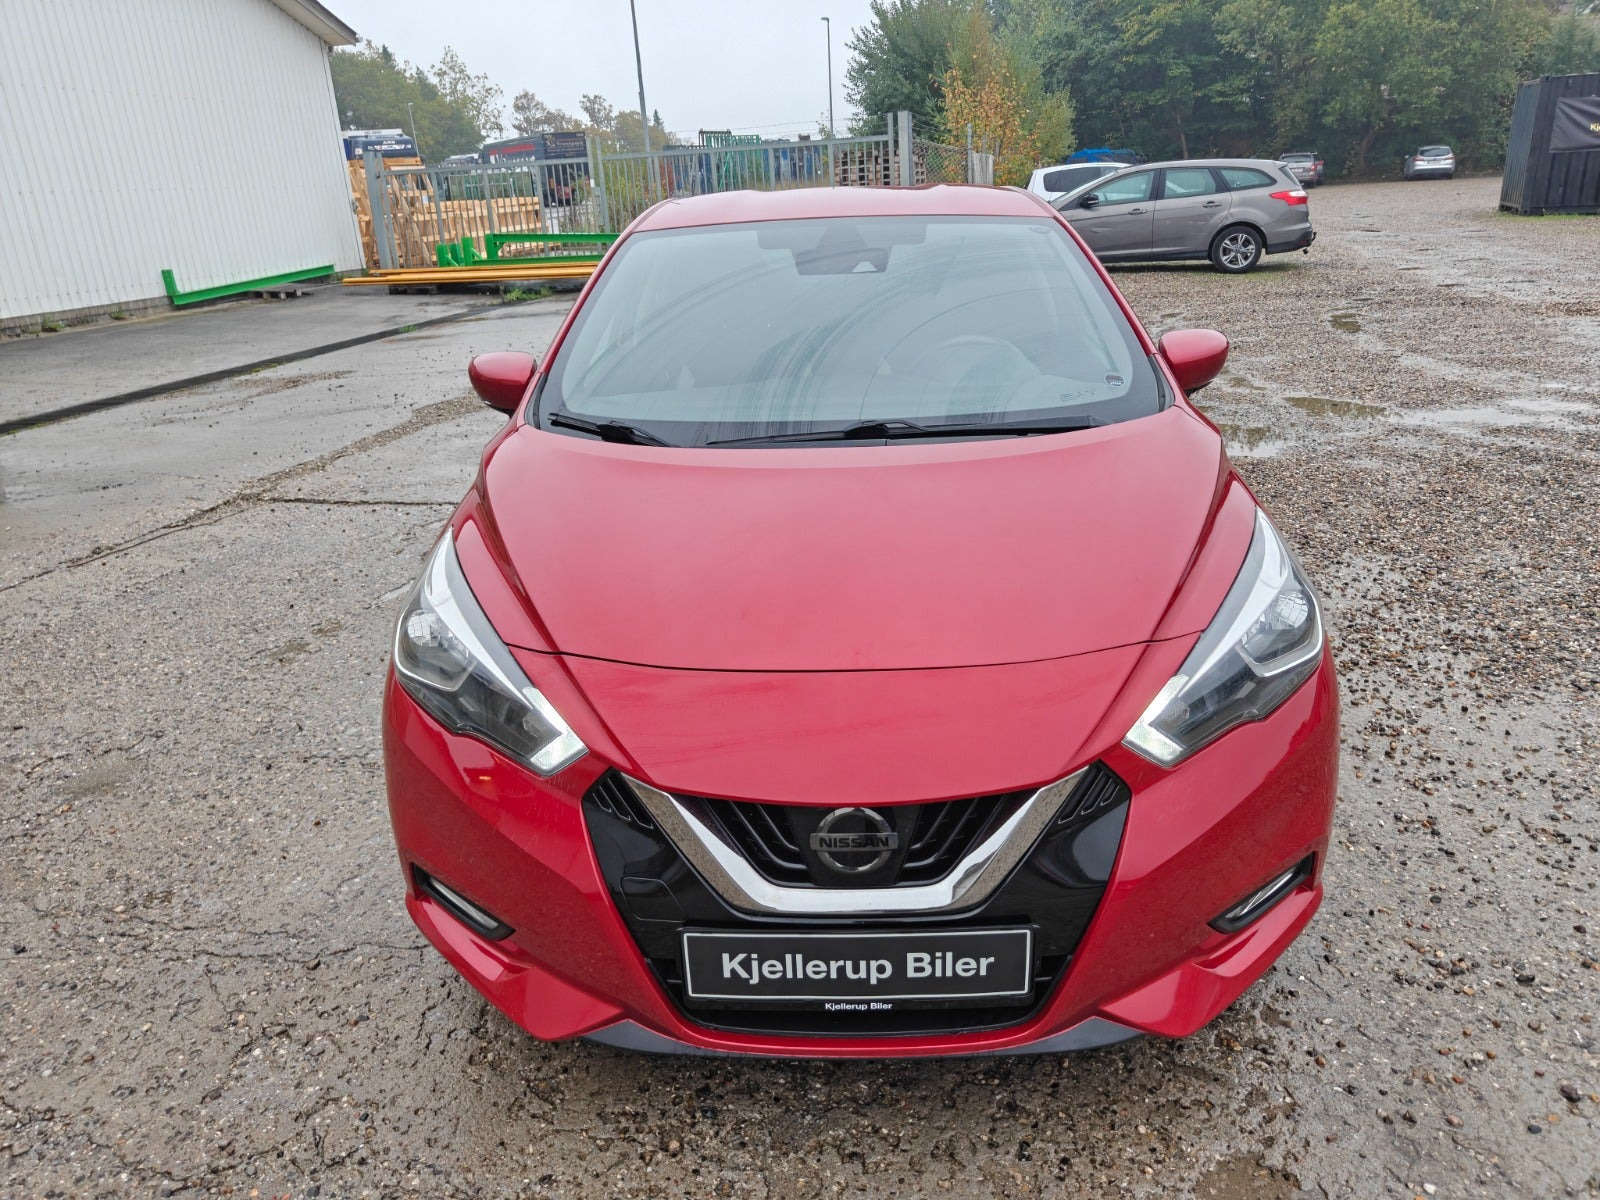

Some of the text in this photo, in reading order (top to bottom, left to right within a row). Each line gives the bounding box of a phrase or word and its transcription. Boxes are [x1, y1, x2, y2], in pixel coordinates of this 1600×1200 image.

[820, 836, 889, 848] NISSAN
[721, 951, 995, 985] Kjellerup Biler
[825, 1002, 893, 1011] Kjellerup Biler
